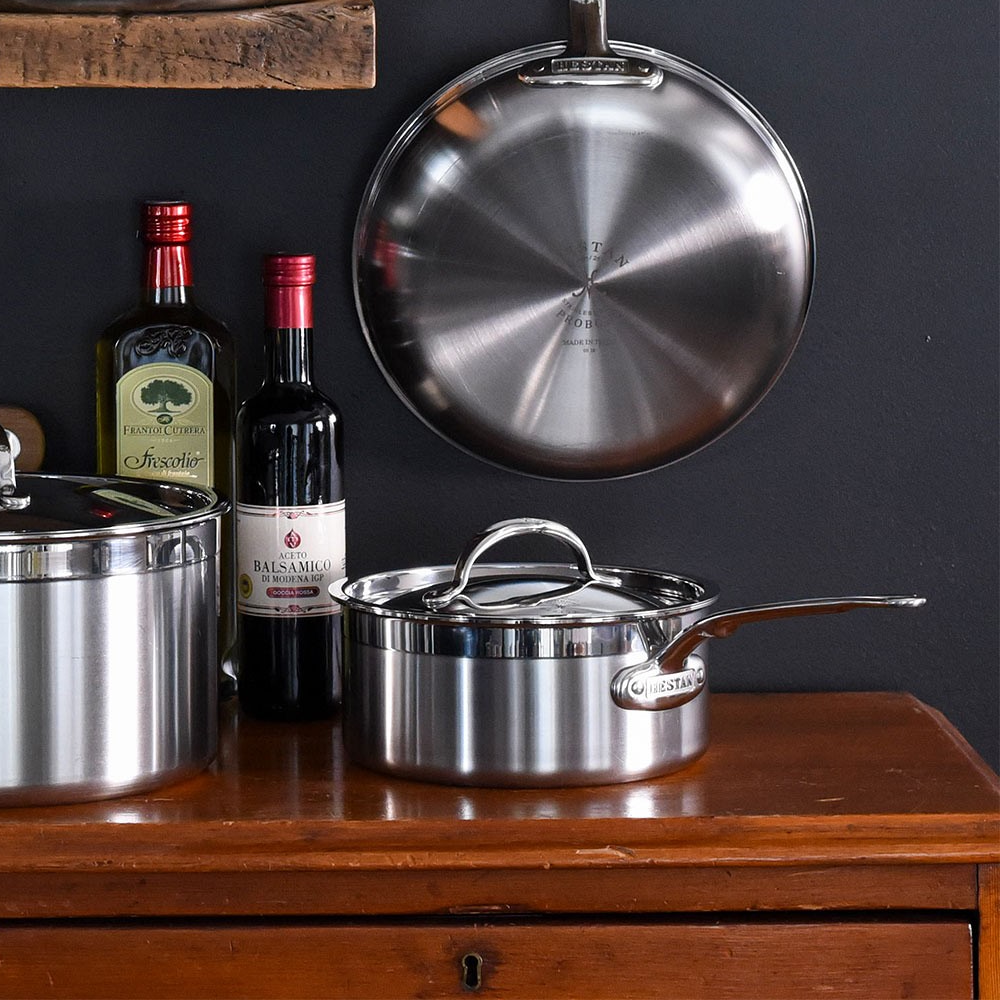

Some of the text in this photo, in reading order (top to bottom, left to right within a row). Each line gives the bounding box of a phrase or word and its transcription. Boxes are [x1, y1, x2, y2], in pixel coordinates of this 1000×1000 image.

[123, 425, 206, 436] FRANTOI CUTRERA
[279, 551, 308, 560] ACETO
[254, 558, 332, 574] BALSAMICO
[261, 573, 325, 583] DI MODENA IGP
